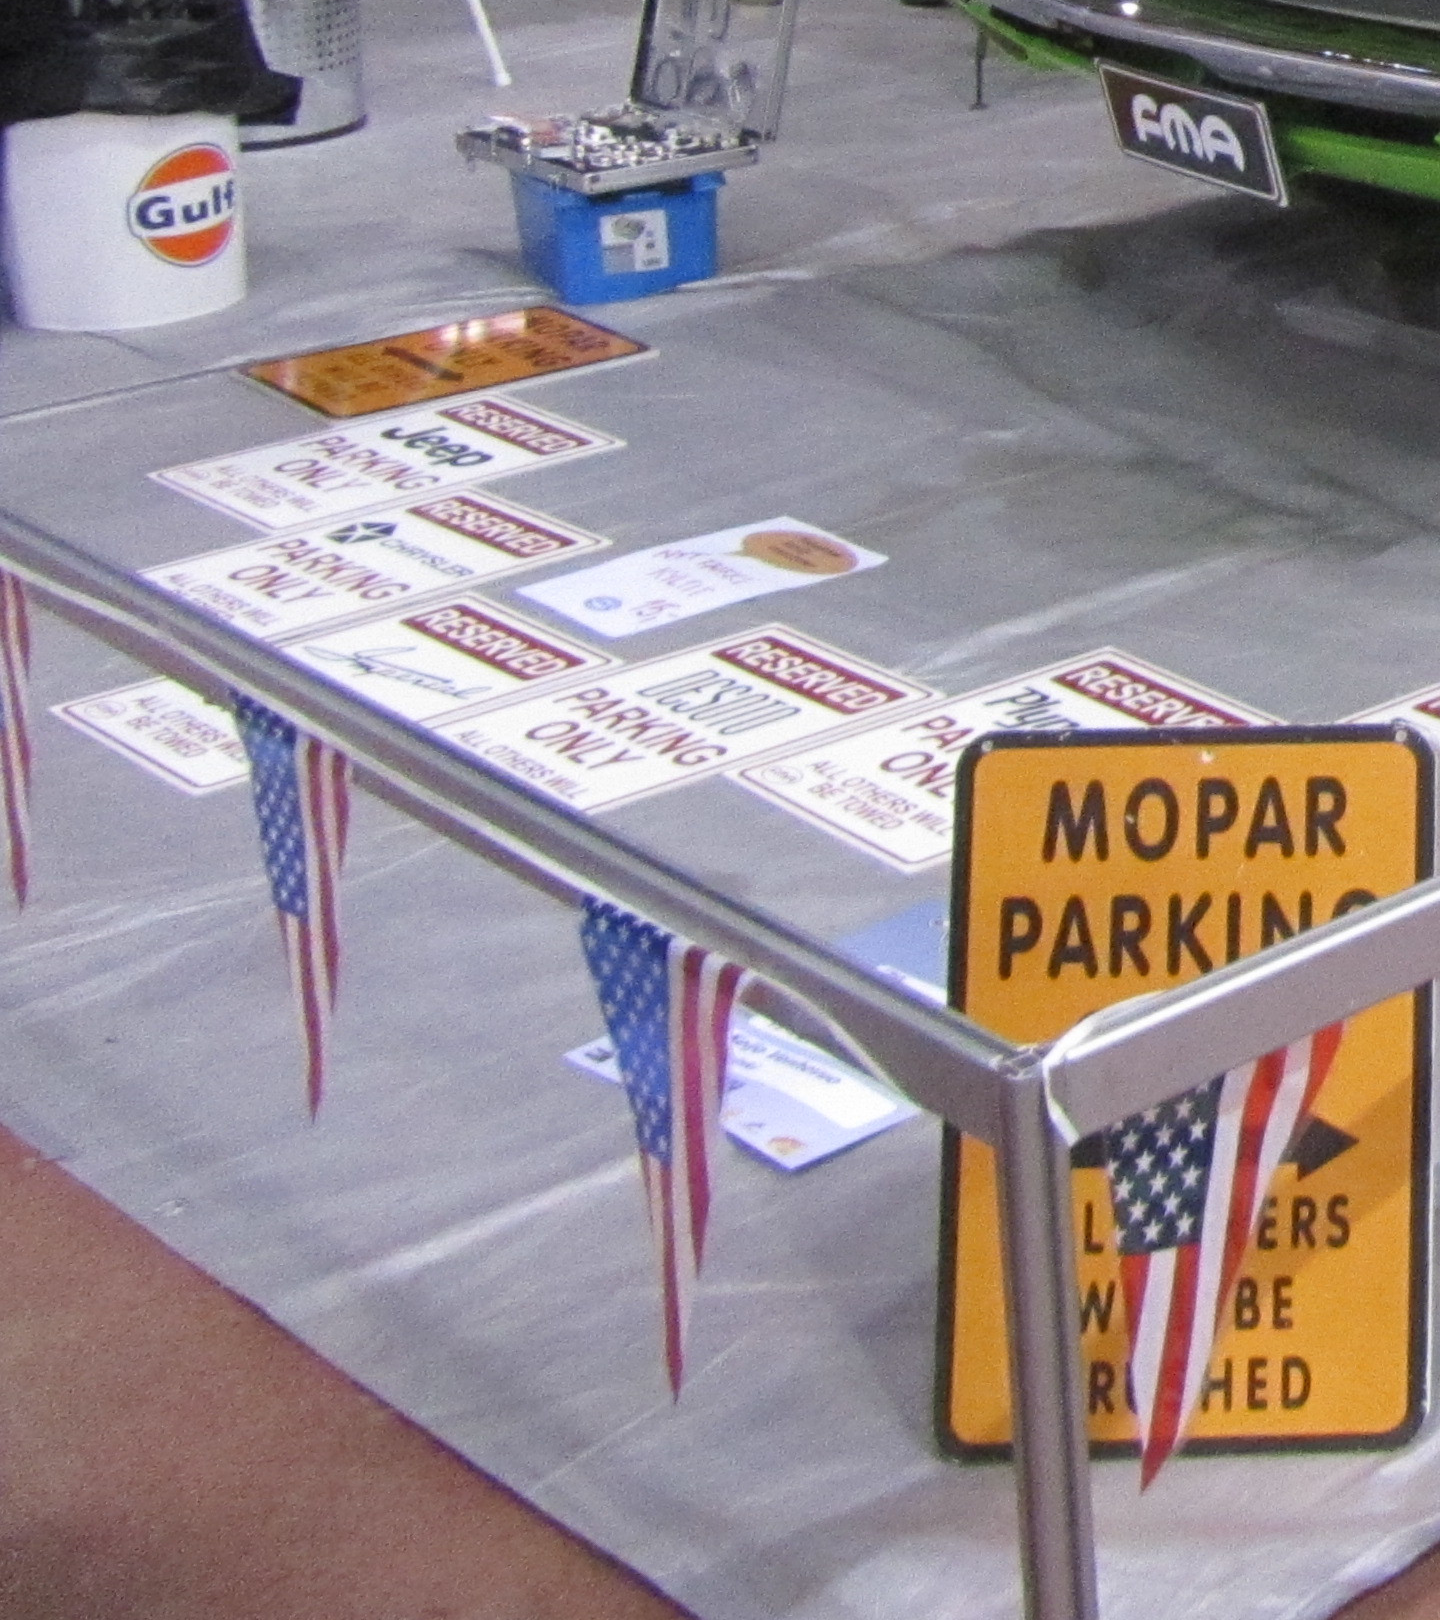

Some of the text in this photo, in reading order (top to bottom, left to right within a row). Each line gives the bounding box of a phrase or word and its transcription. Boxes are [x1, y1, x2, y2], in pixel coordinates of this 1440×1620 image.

[1131, 92, 1246, 173] FMA
[135, 178, 236, 230] Gulf
[380, 426, 494, 468] Jeep
[448, 403, 579, 453] RESERVED
[273, 458, 376, 493] ONLY
[301, 435, 440, 490] PARKING
[418, 498, 565, 557] RESERVED
[227, 564, 338, 603] ONLY
[258, 538, 412, 602] PARKING
[377, 537, 477, 579] CHRYSLER
[414, 609, 570, 677] RESERVED
[728, 639, 892, 712] RESERVED
[525, 720, 648, 771] ONLY
[553, 686, 729, 768] PARKING
[807, 760, 848, 780] ALL
[841, 776, 919, 815] OTHERS
[879, 750, 956, 799] ONL
[836, 794, 905, 830] TOWED
[1041, 775, 1348, 863] MOPAR
[1234, 1275, 1294, 1332] BE
